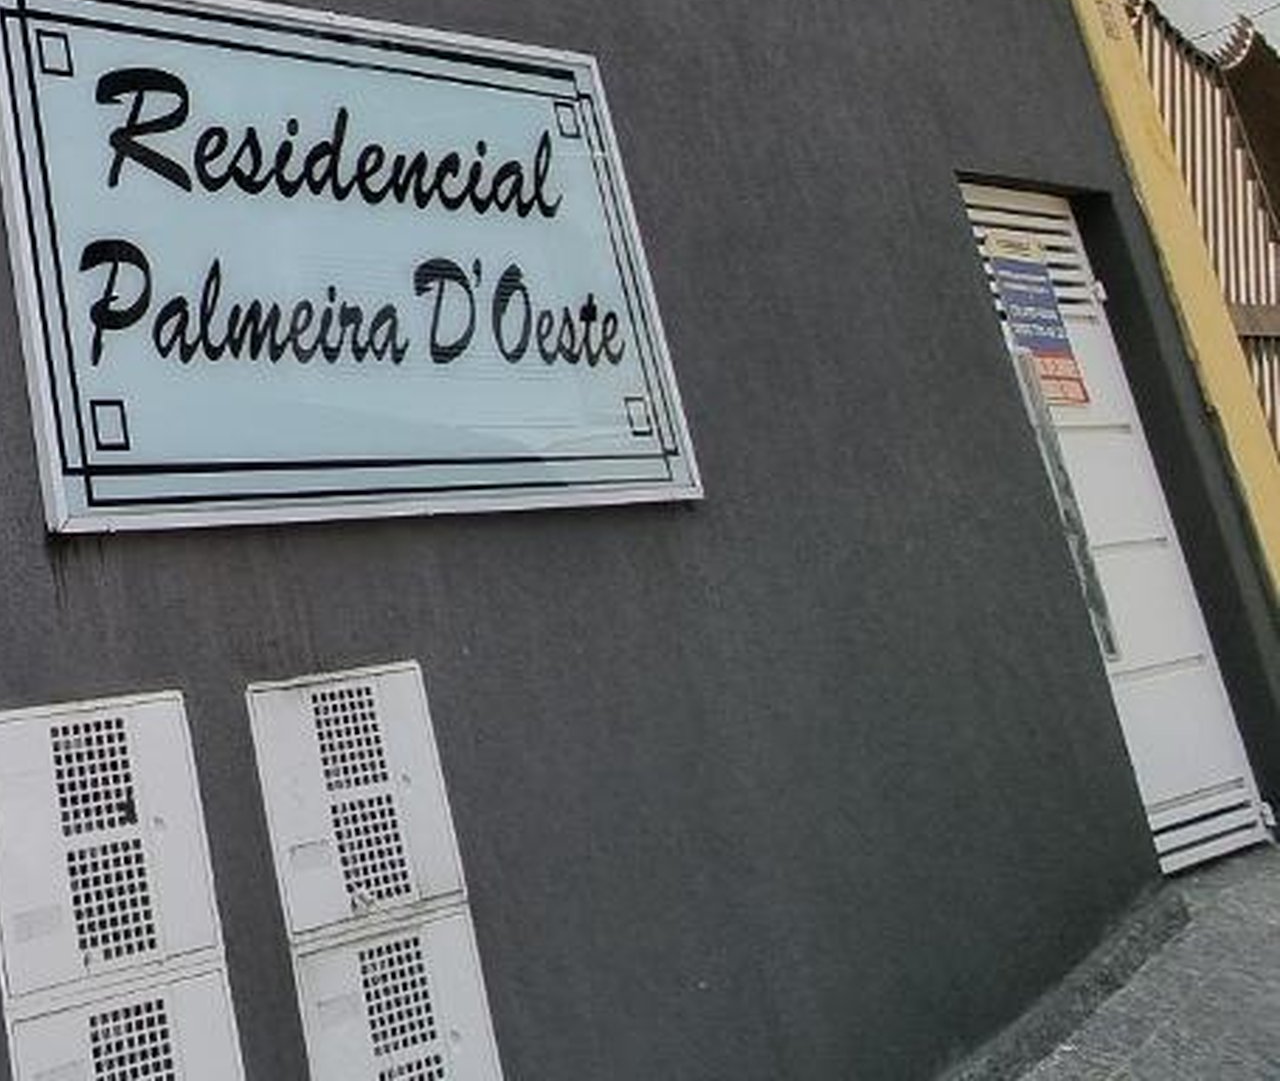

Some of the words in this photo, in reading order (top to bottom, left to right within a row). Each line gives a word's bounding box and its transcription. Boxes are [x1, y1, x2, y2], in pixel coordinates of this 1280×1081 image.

[95, 66, 563, 218] Residencial
[79, 238, 409, 366] Palmeira
[413, 257, 626, 367] D'Oeste
